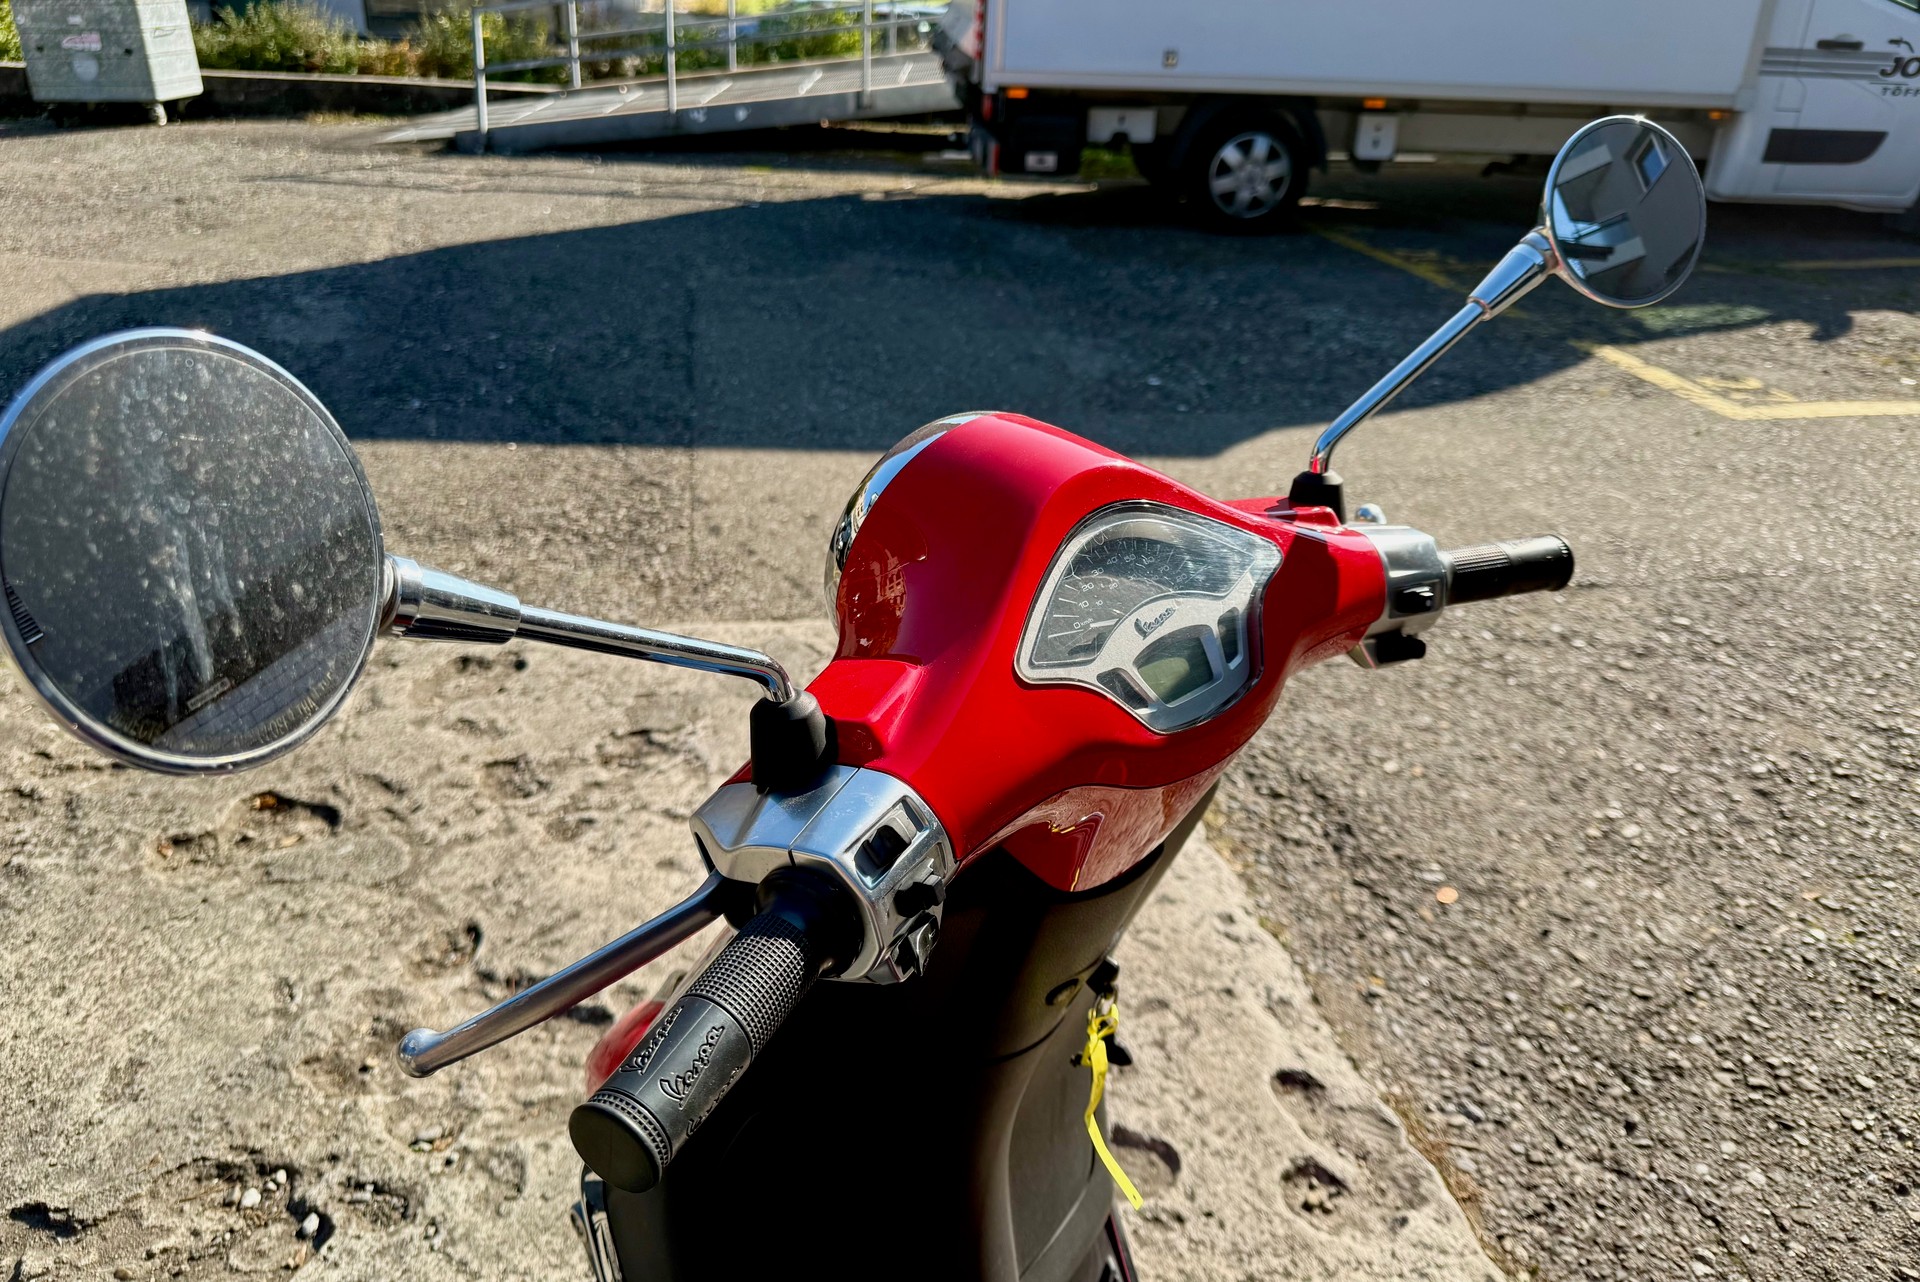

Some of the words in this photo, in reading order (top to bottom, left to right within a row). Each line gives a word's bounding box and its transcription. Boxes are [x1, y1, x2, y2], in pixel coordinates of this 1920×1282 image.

[1091, 567, 1104, 576] 30
[1081, 582, 1095, 592] 20
[1078, 600, 1090, 609] 10
[1134, 606, 1177, 641] Vespa
[619, 1004, 685, 1076] Vespa
[658, 1023, 726, 1110] Vespa
